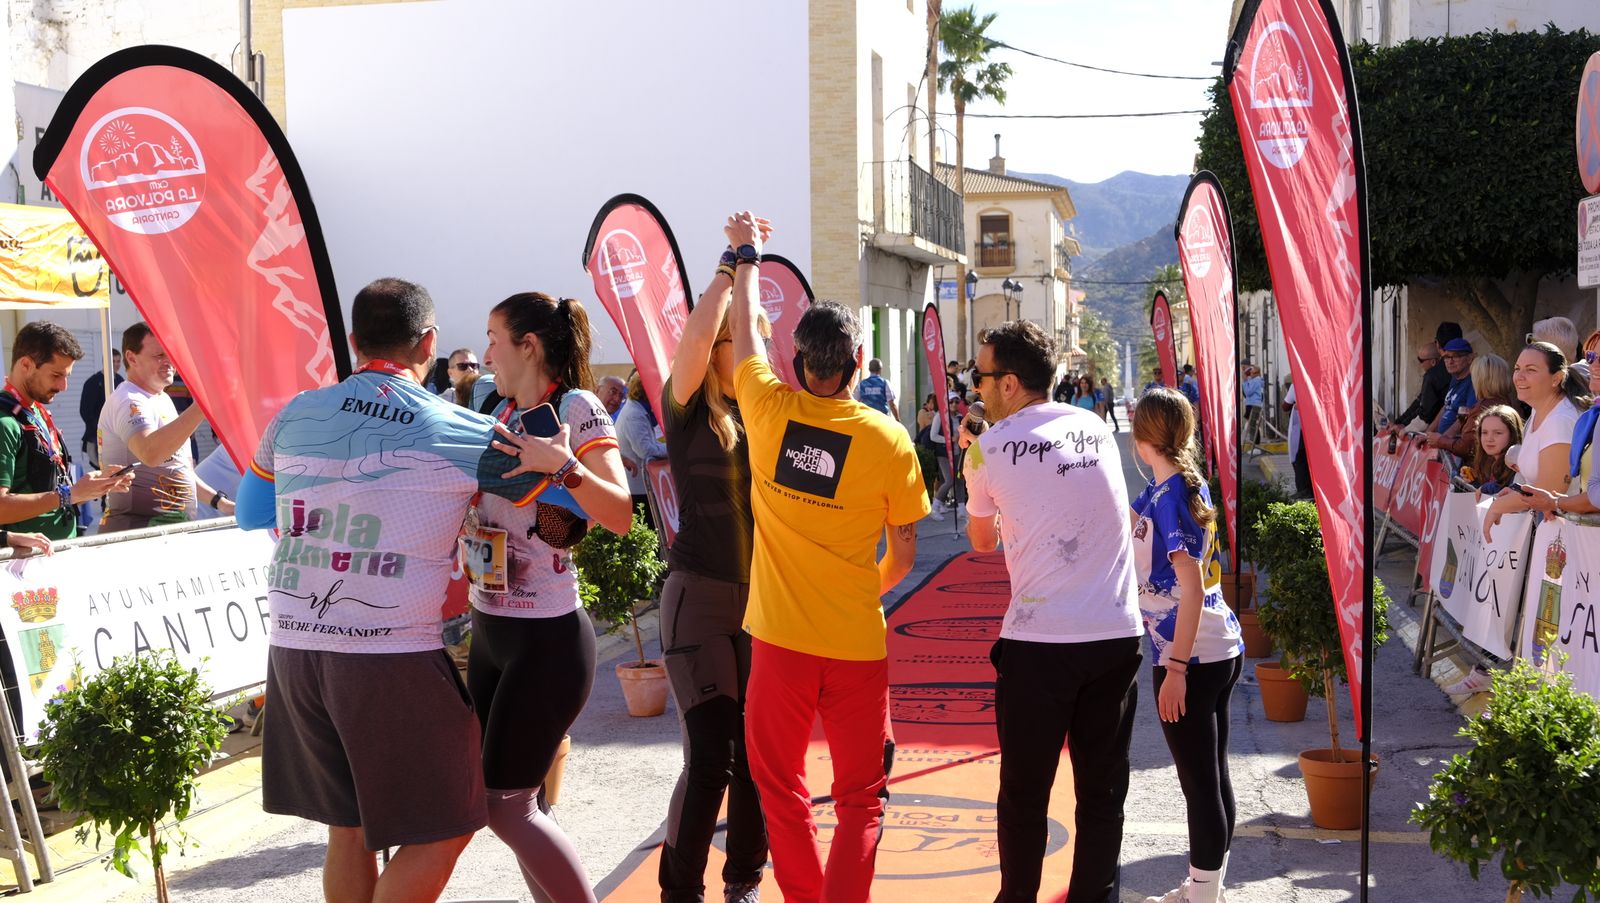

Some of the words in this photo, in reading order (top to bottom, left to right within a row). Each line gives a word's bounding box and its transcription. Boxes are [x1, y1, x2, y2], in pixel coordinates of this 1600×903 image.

[340, 397, 415, 425] EMILIO
[785, 448, 820, 466] NORTH
[803, 444, 822, 458] THE
[1002, 440, 1065, 466] Pepe
[792, 459, 817, 474] FACE
[1056, 456, 1100, 477] speaker
[763, 479, 782, 495] NEVER
[784, 491, 801, 502] STOP
[802, 498, 844, 511] EXPLORING
[278, 619, 313, 632] RECHE
[312, 623, 393, 638] FERNÁNDEZ
